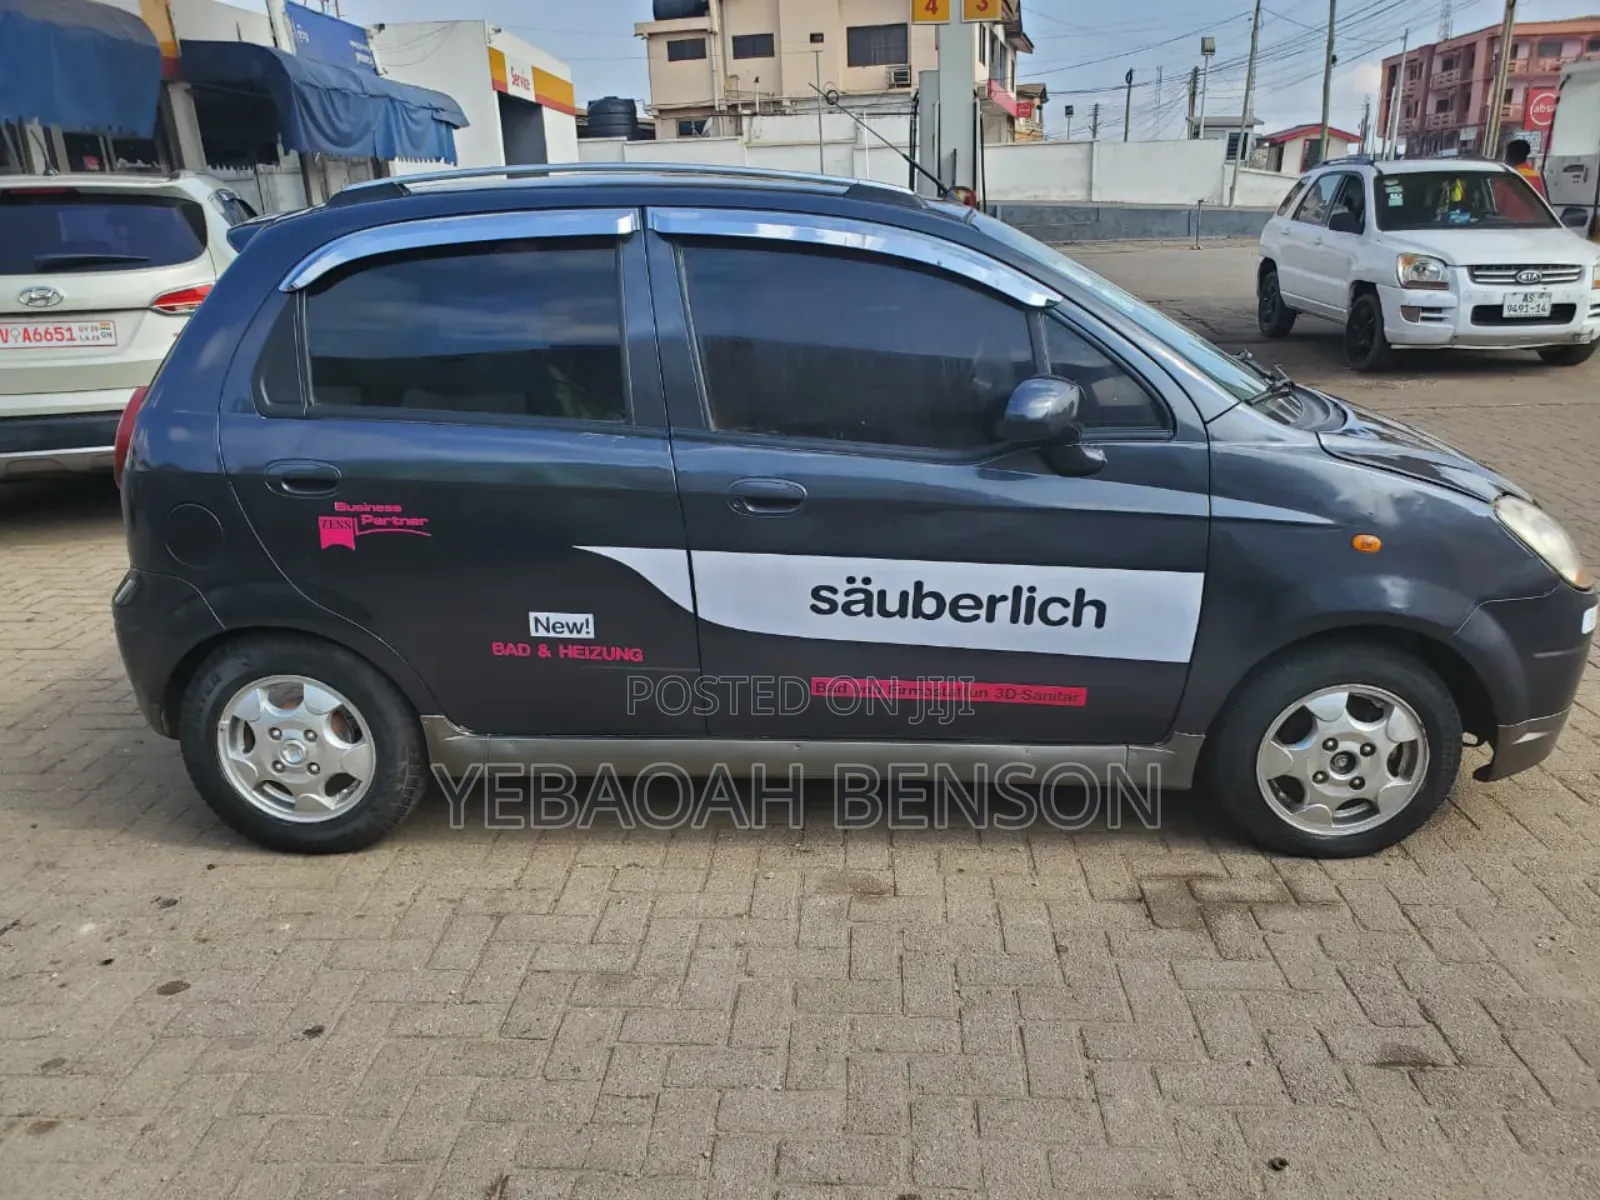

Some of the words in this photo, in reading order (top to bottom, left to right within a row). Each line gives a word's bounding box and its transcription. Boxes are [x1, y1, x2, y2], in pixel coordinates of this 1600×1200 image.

[510, 65, 531, 91] Service
[1520, 272, 1538, 281] KIA
[1522, 293, 1536, 303] AS
[22, 326, 76, 343] A6651
[334, 501, 402, 512] Business
[360, 514, 429, 526] Partner
[809, 575, 1107, 630] säuberlich
[533, 616, 591, 635] New!
[491, 641, 531, 657] BAD
[537, 643, 552, 658] &
[558, 644, 644, 662] HEIZUNG
